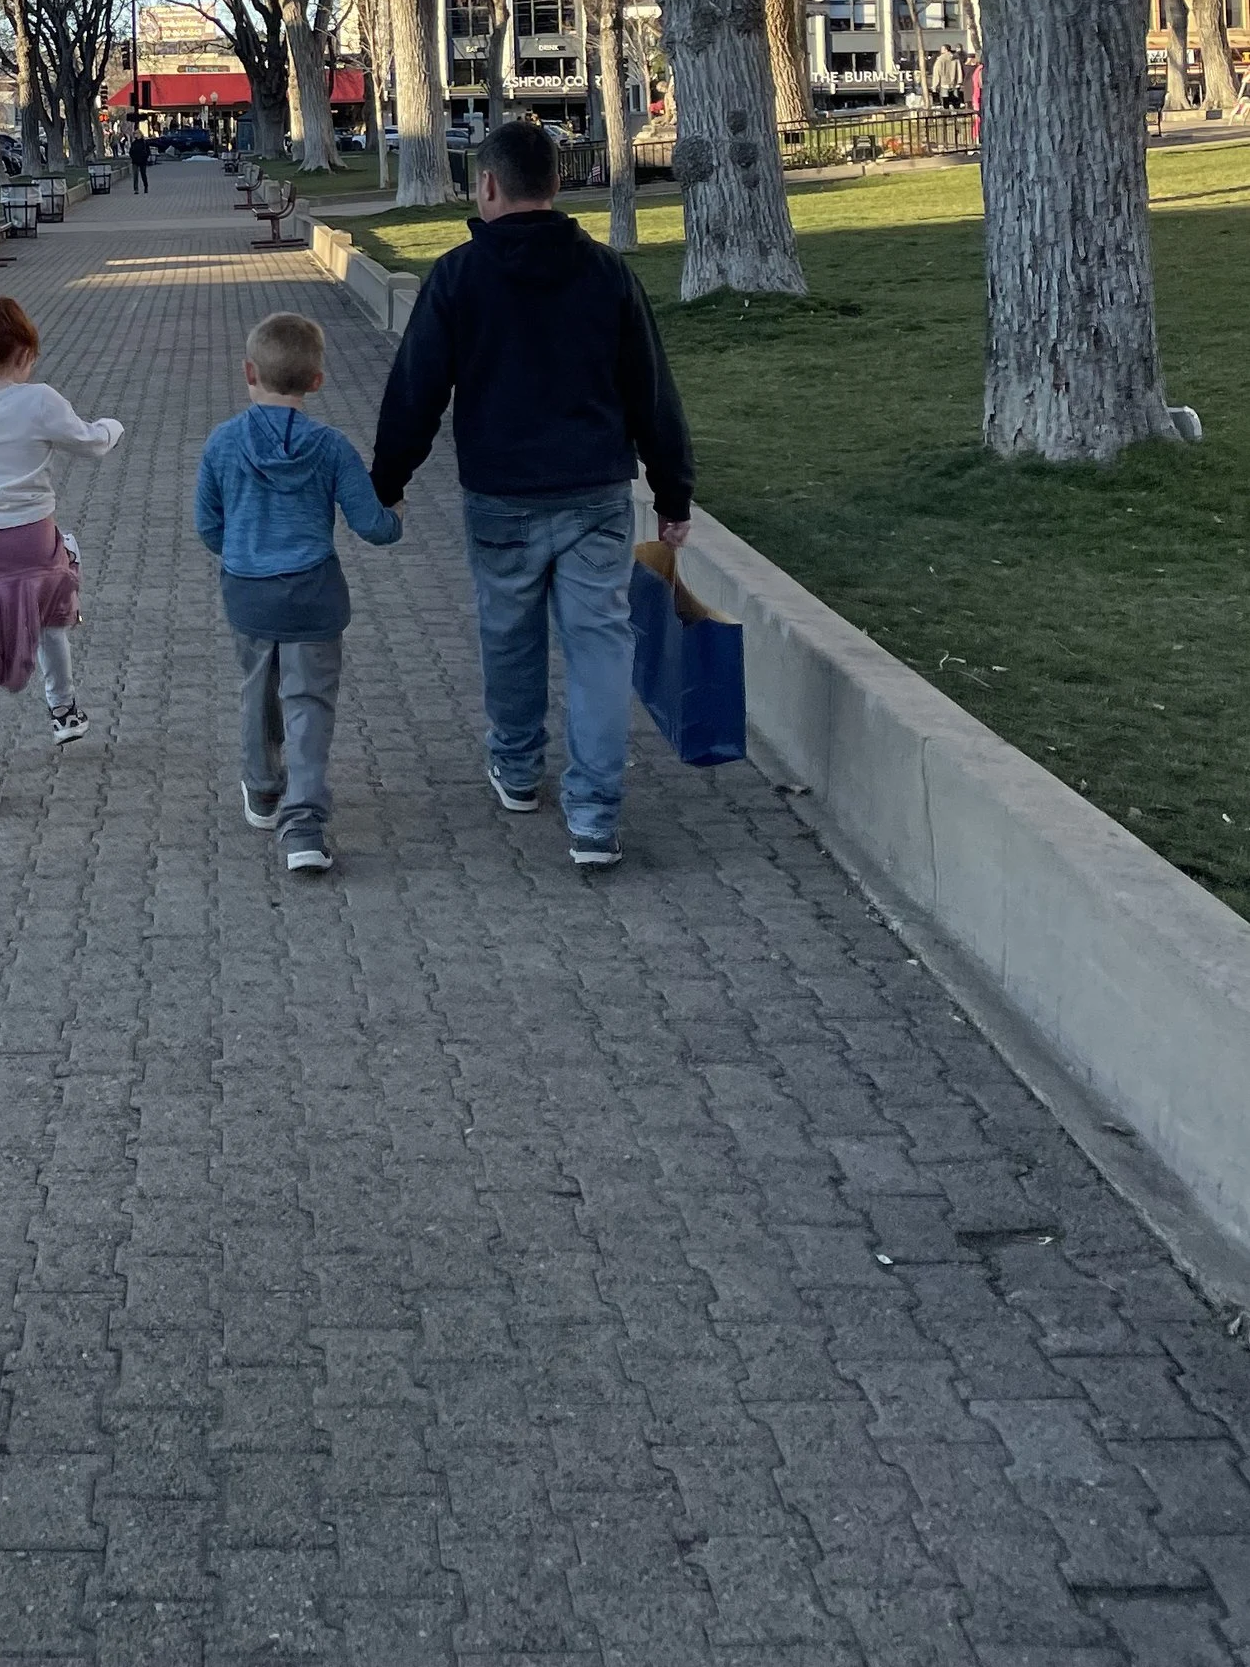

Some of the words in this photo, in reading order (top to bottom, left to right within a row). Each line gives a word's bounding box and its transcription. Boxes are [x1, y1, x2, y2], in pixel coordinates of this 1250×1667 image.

[466, 45, 478, 53] EAT
[538, 44, 559, 52] DRINK
[502, 75, 562, 88] ASHFORD
[813, 71, 838, 83] THE
